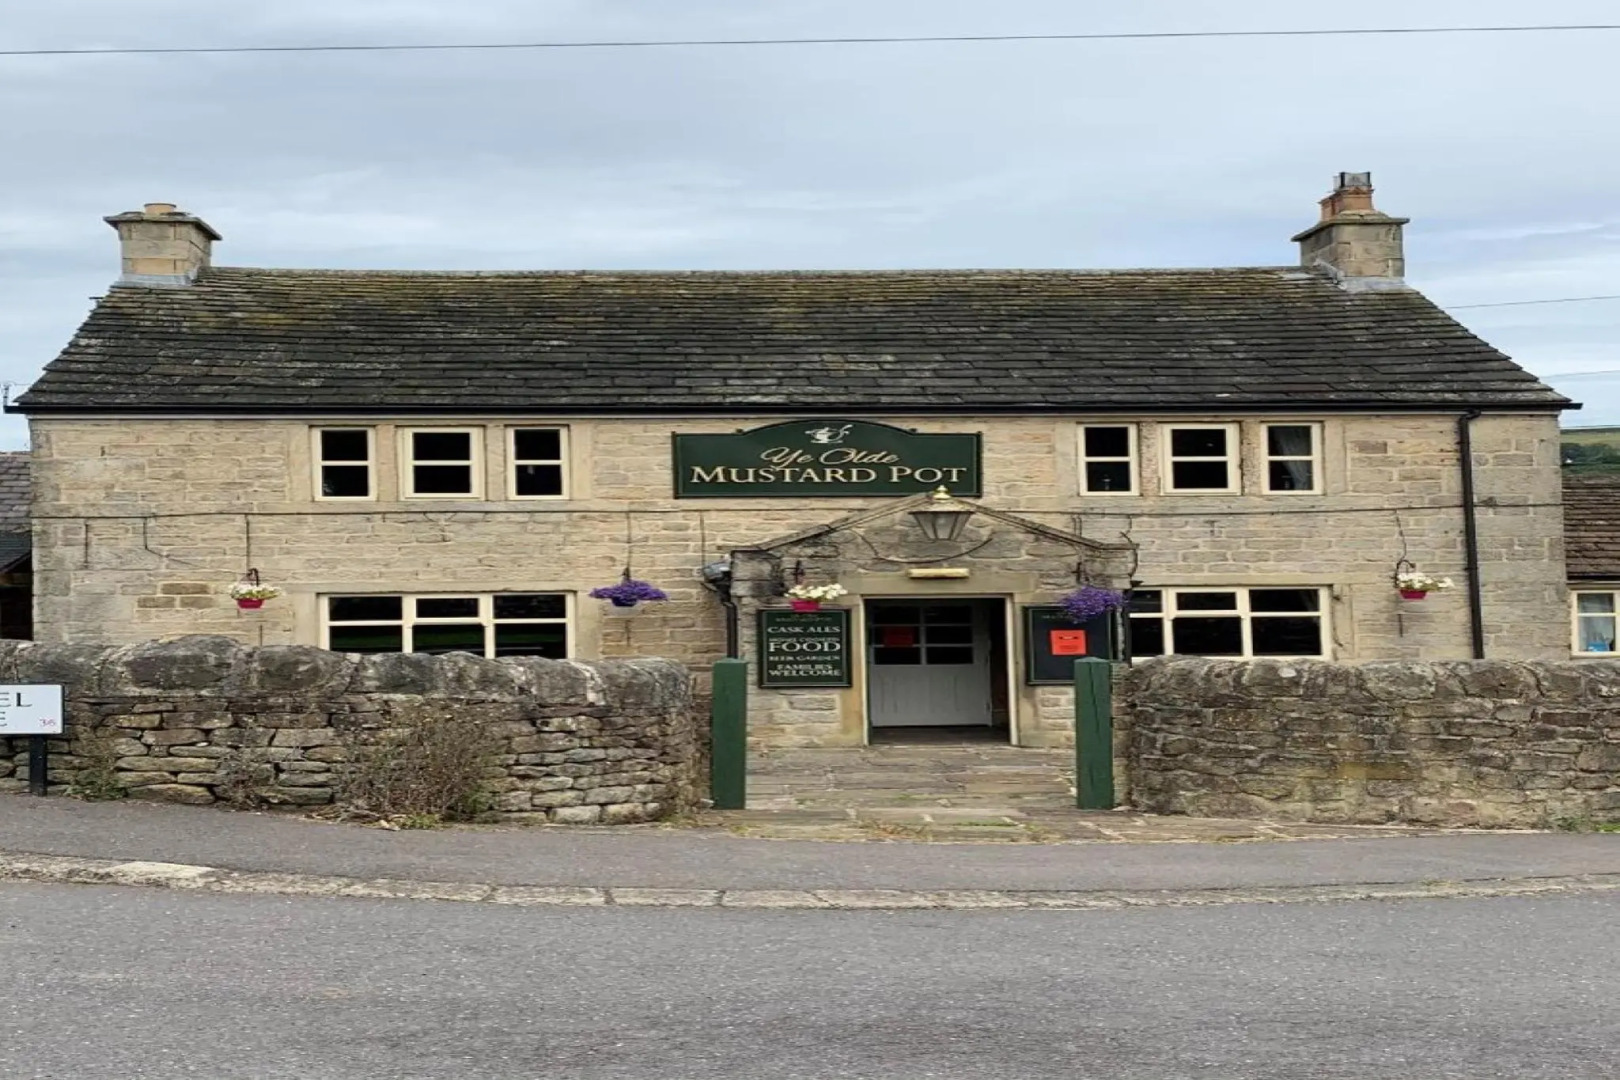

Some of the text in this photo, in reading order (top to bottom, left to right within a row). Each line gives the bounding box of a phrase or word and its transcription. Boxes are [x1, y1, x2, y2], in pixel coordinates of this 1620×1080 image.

[760, 446, 901, 468] Ye Olde
[690, 465, 967, 483] MUSTARD POT
[768, 642, 841, 652] FOOD
[768, 669, 842, 677] WELCOME
